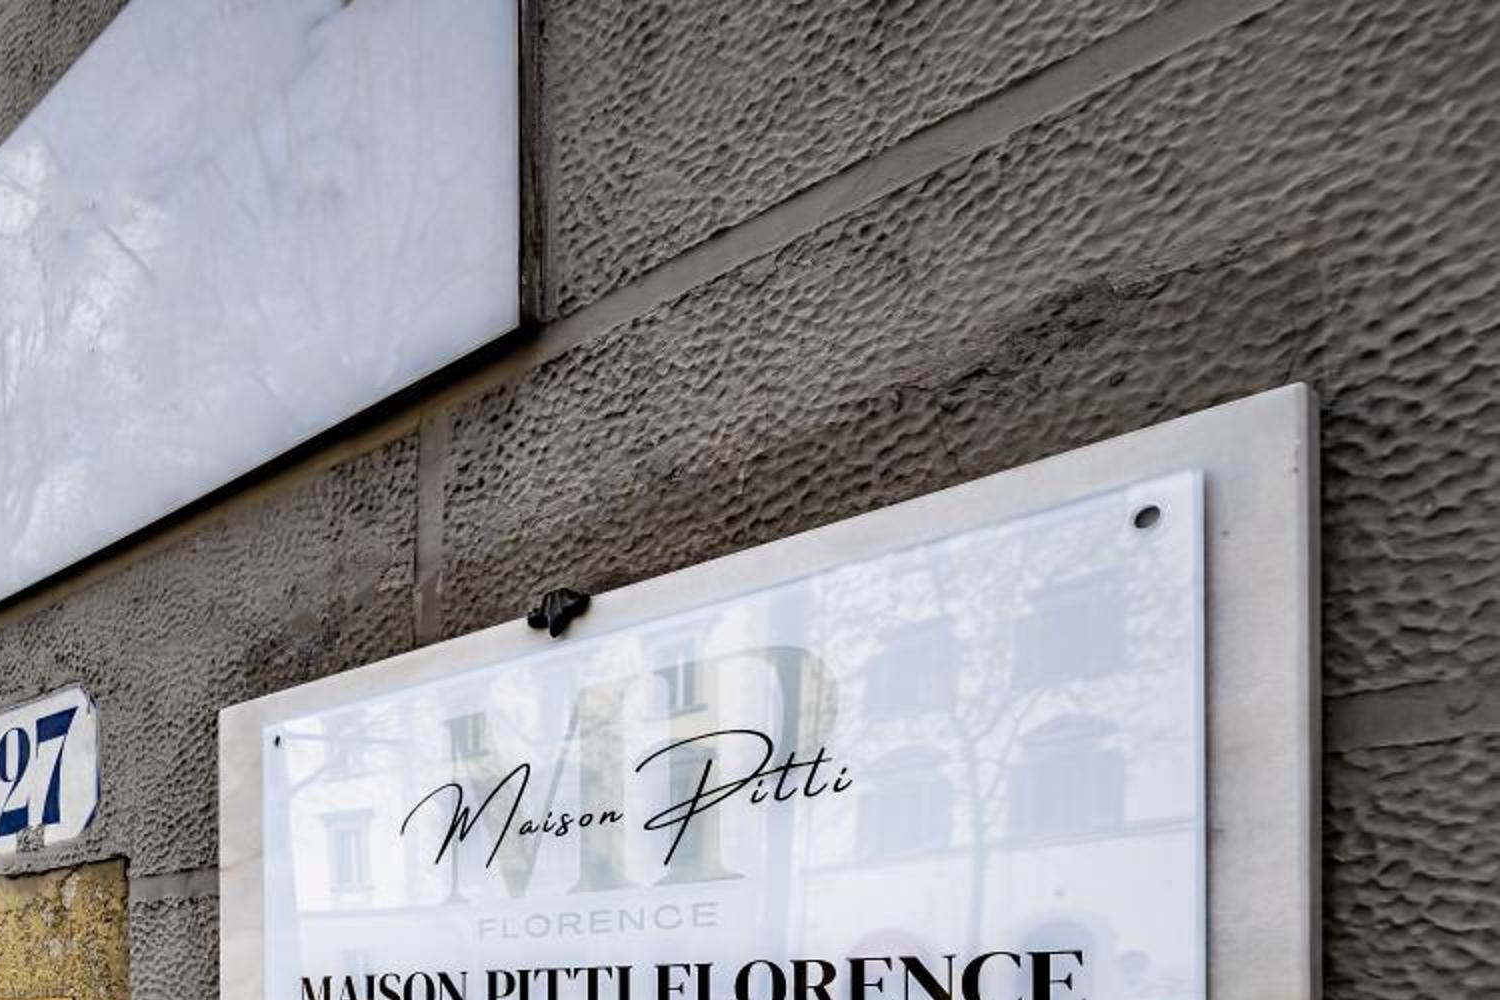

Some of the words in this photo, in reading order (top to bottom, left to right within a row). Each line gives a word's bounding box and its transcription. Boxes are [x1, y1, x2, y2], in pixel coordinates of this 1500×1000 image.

[401, 763, 623, 868] Maison
[635, 729, 853, 866] Pitti
[477, 900, 720, 942] FLORENCE
